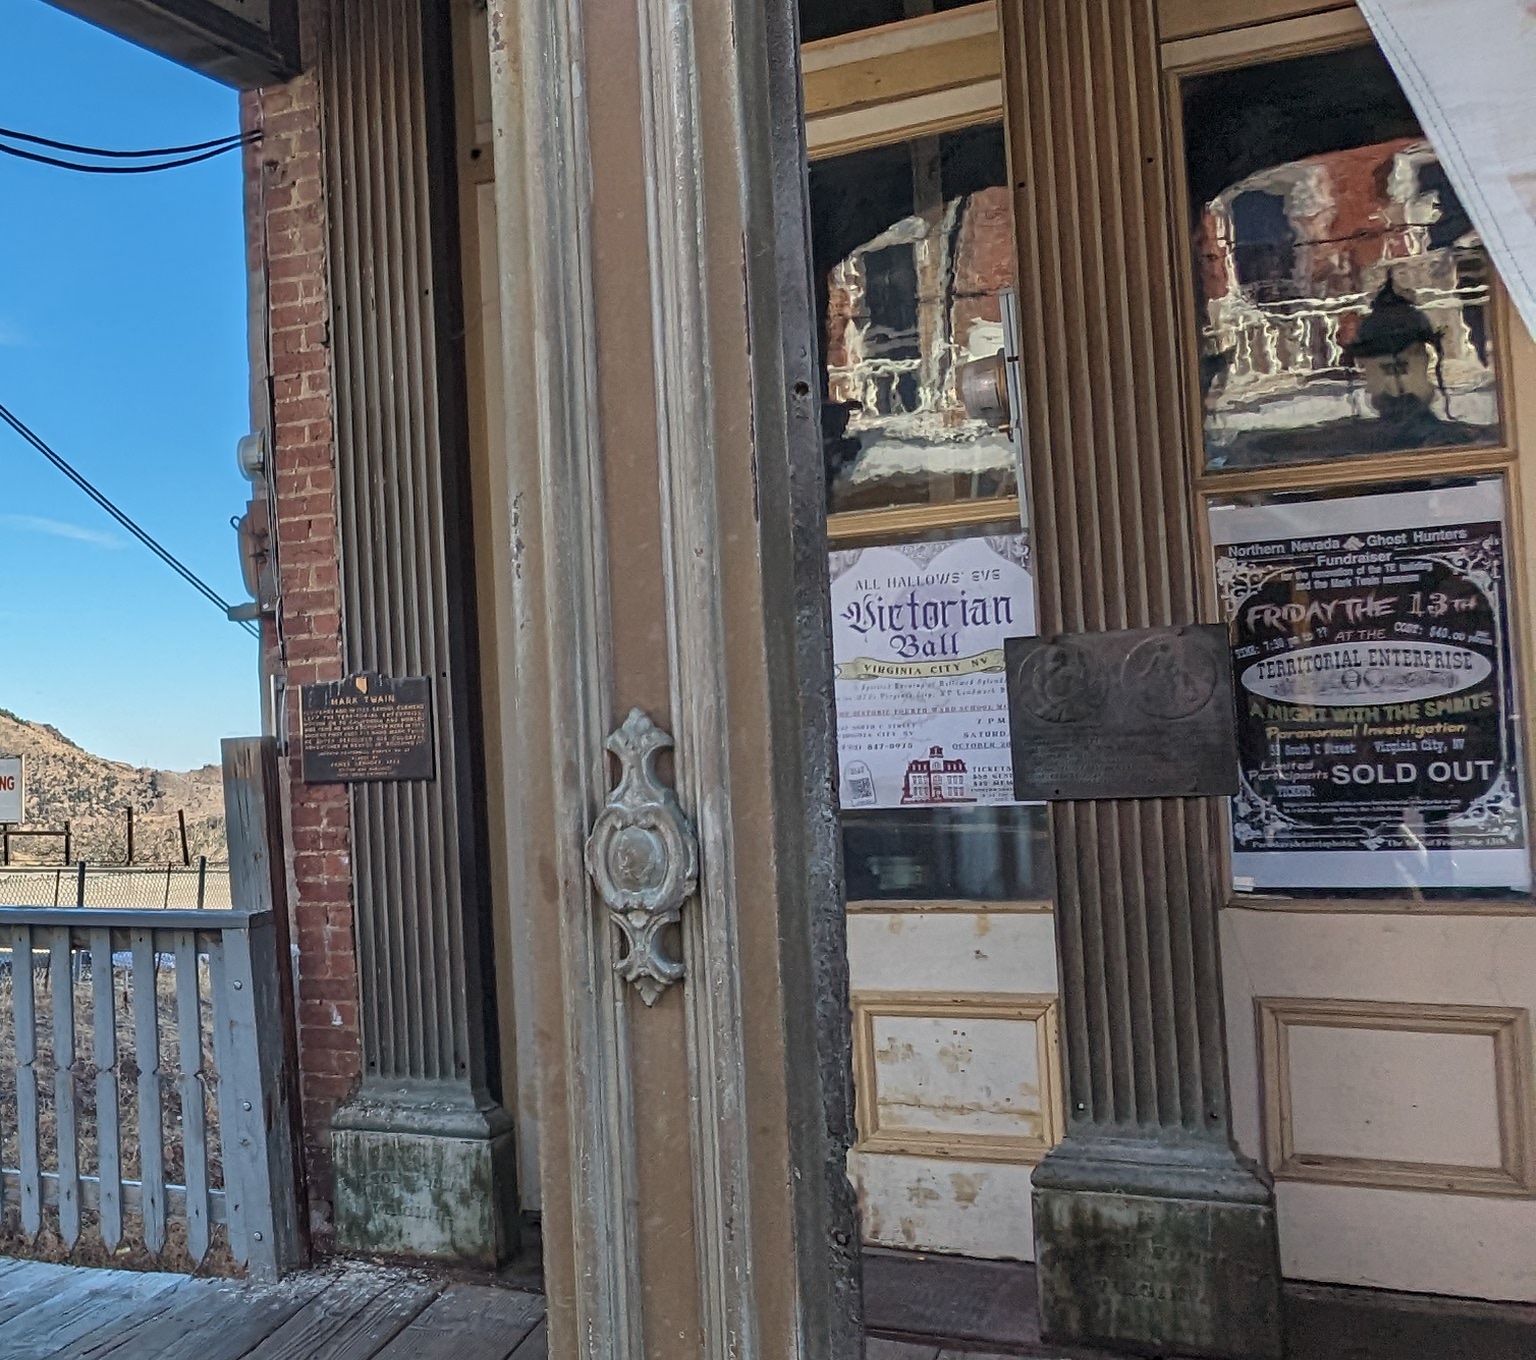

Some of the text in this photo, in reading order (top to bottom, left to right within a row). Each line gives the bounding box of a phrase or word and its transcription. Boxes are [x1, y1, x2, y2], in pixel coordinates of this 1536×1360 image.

[1228, 528, 1468, 557] Northern Nevada Ghost Hunters
[1317, 552, 1393, 567] Fundraiser
[855, 576, 881, 591] ALL
[971, 568, 1002, 582] EVE
[840, 589, 1014, 636] Victorian
[1246, 598, 1340, 633] FRIDAY
[1340, 590, 1399, 625] THE
[889, 631, 960, 659] Ball
[1334, 629, 1386, 641] AT THE
[864, 656, 989, 675] VIRGINIA CITY NV
[1256, 649, 1362, 680] TERRITORIAL
[1369, 649, 1473, 671] ENTERPRISE
[331, 694, 396, 706] MARK TWAIN
[1250, 691, 1493, 723] A NIGHT WITH THE SPIRITS
[963, 731, 1010, 739] SATURD
[1265, 722, 1467, 740] Paranormal Investigation
[1374, 739, 1417, 755] Virginia
[1452, 738, 1465, 750] NV
[1332, 760, 1495, 785] SOLD OUT
